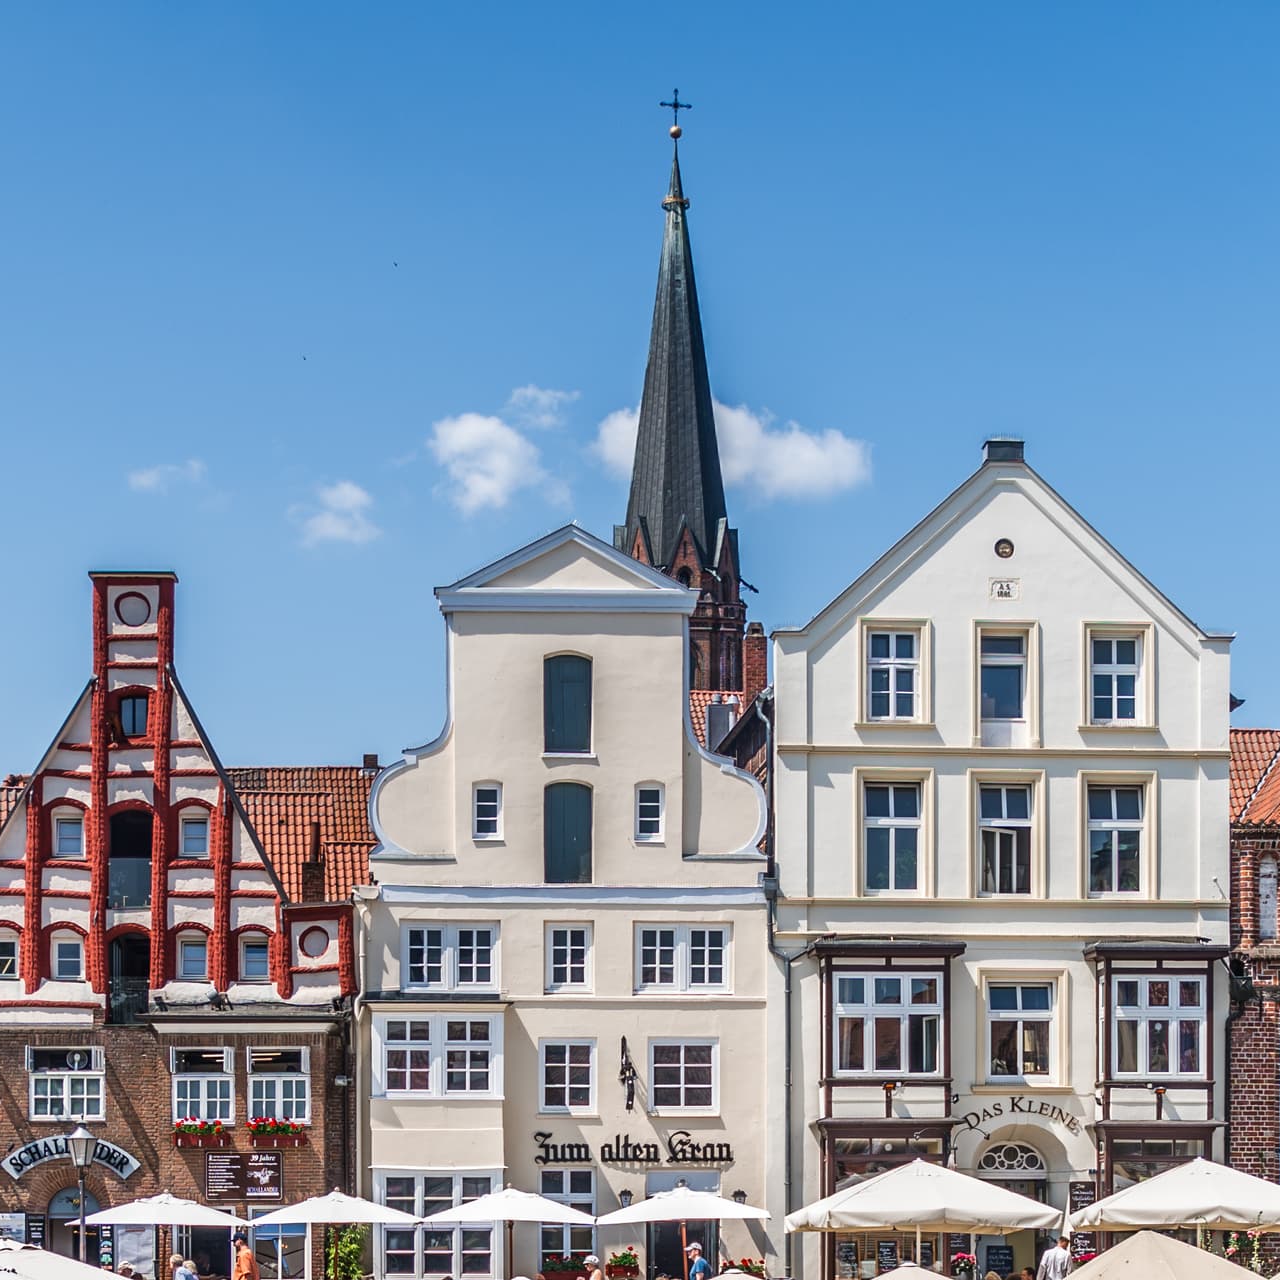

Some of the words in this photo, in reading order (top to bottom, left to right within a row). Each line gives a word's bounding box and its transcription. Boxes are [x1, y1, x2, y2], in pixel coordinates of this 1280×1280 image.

[963, 1103, 1003, 1129] DAS
[250, 1154, 259, 1162] 39
[259, 1154, 276, 1162] Jahre
[534, 1131, 592, 1165] Zum
[600, 1134, 661, 1163] alten
[666, 1130, 734, 1163] Kran
